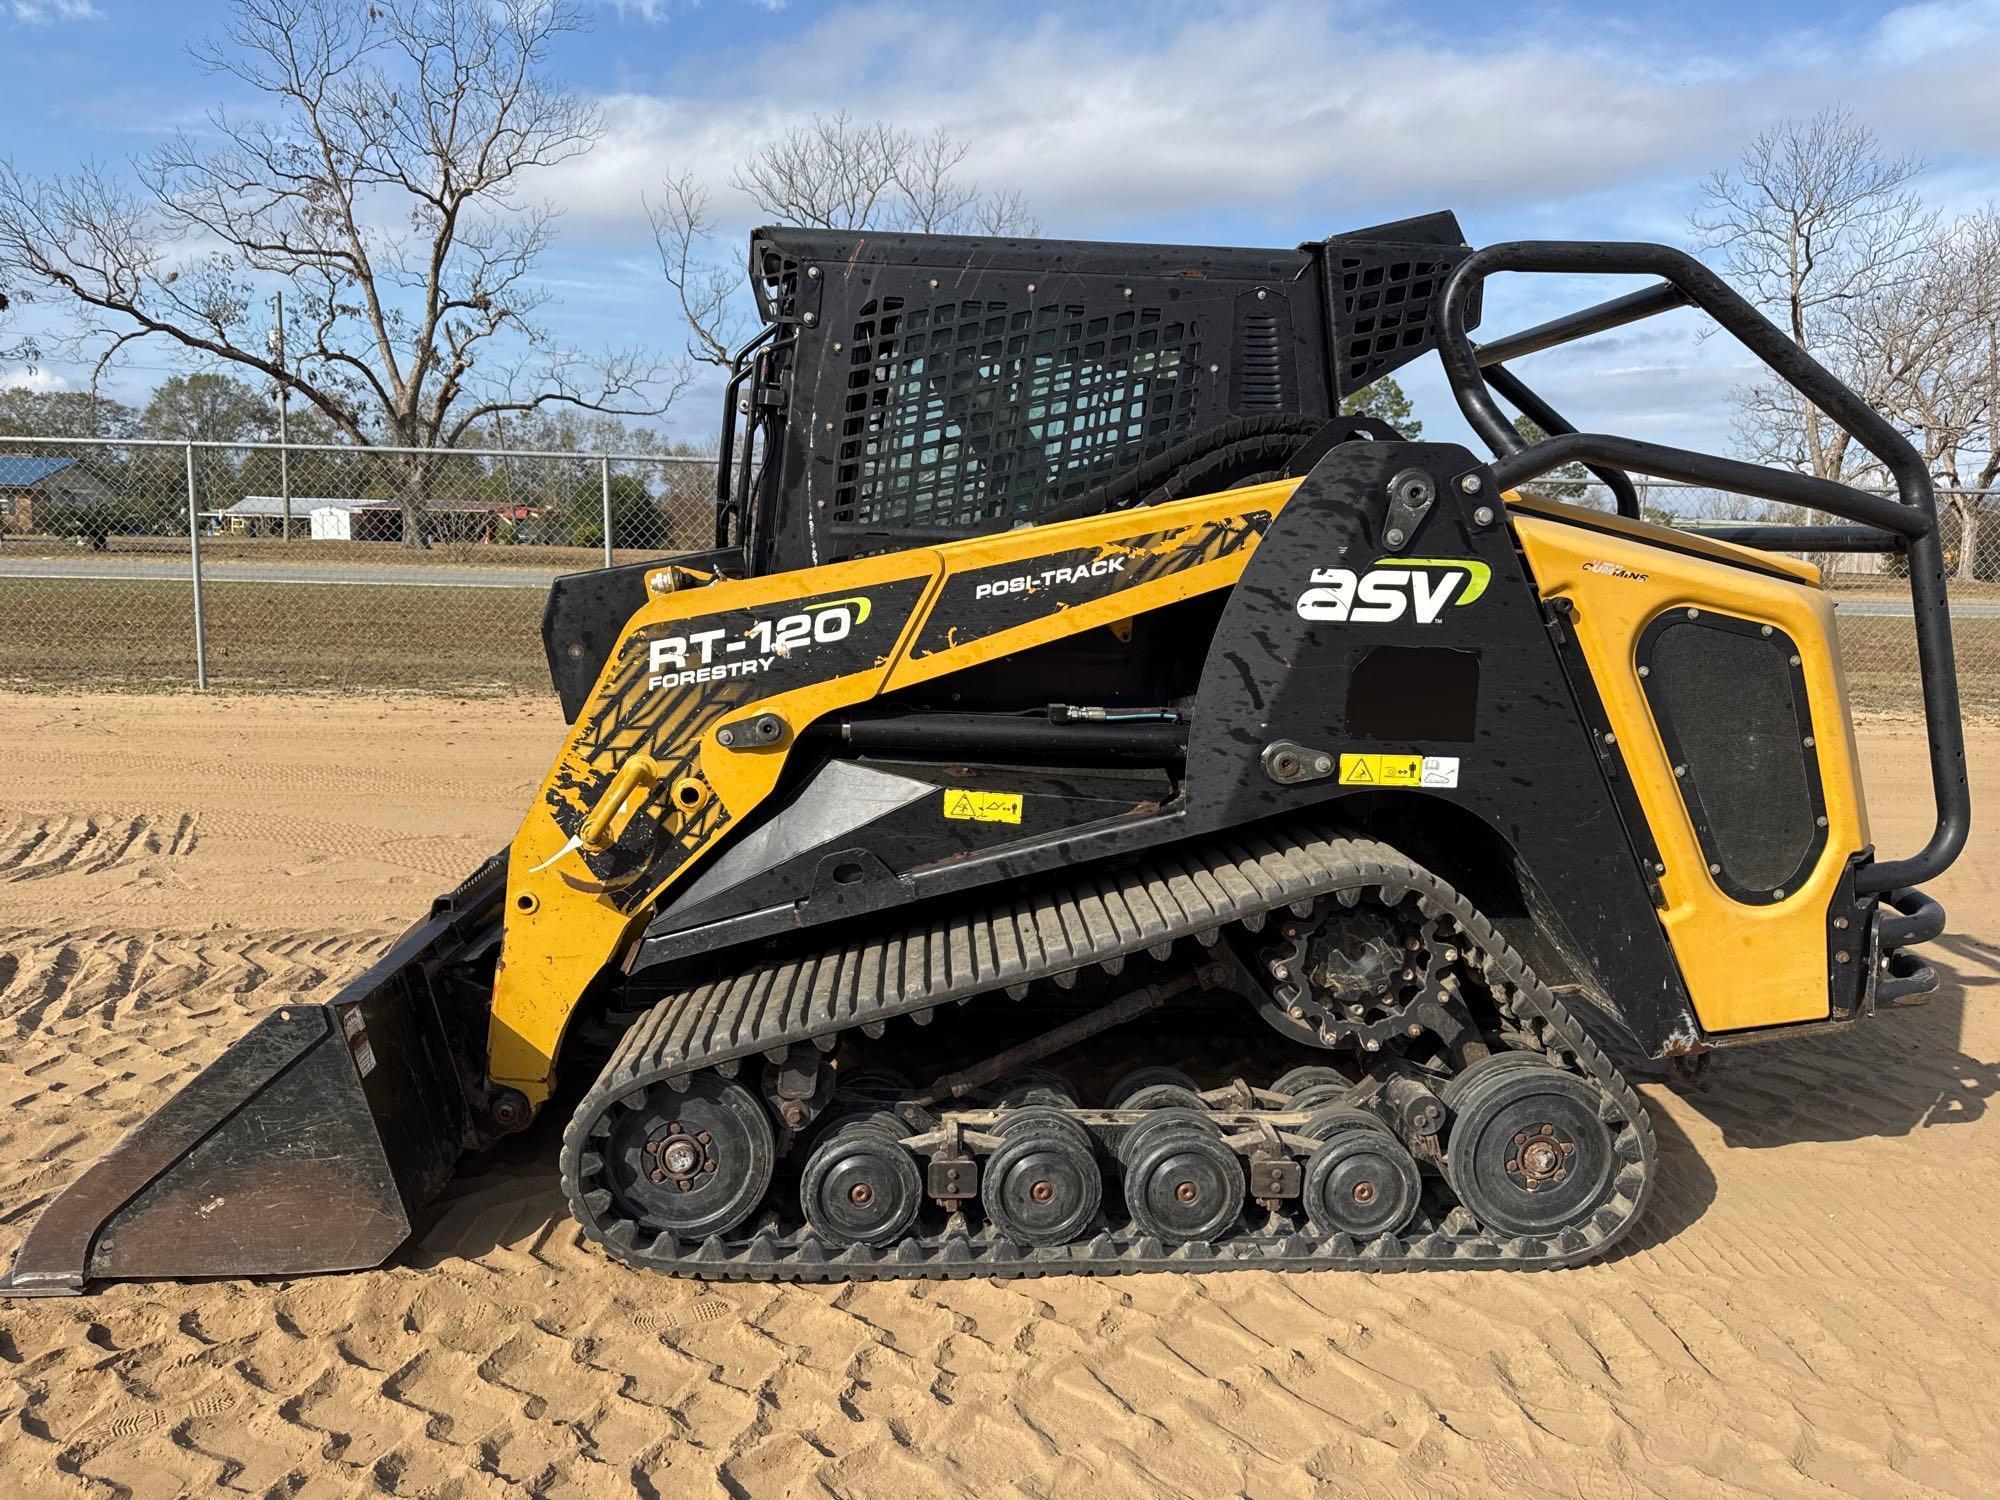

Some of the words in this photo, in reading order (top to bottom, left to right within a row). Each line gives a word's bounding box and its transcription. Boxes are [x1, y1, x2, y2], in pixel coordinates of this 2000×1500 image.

[976, 557, 1125, 599] POSI-TRACK
[650, 608, 851, 672] RT-120
[649, 656, 775, 691] FORESTRY
